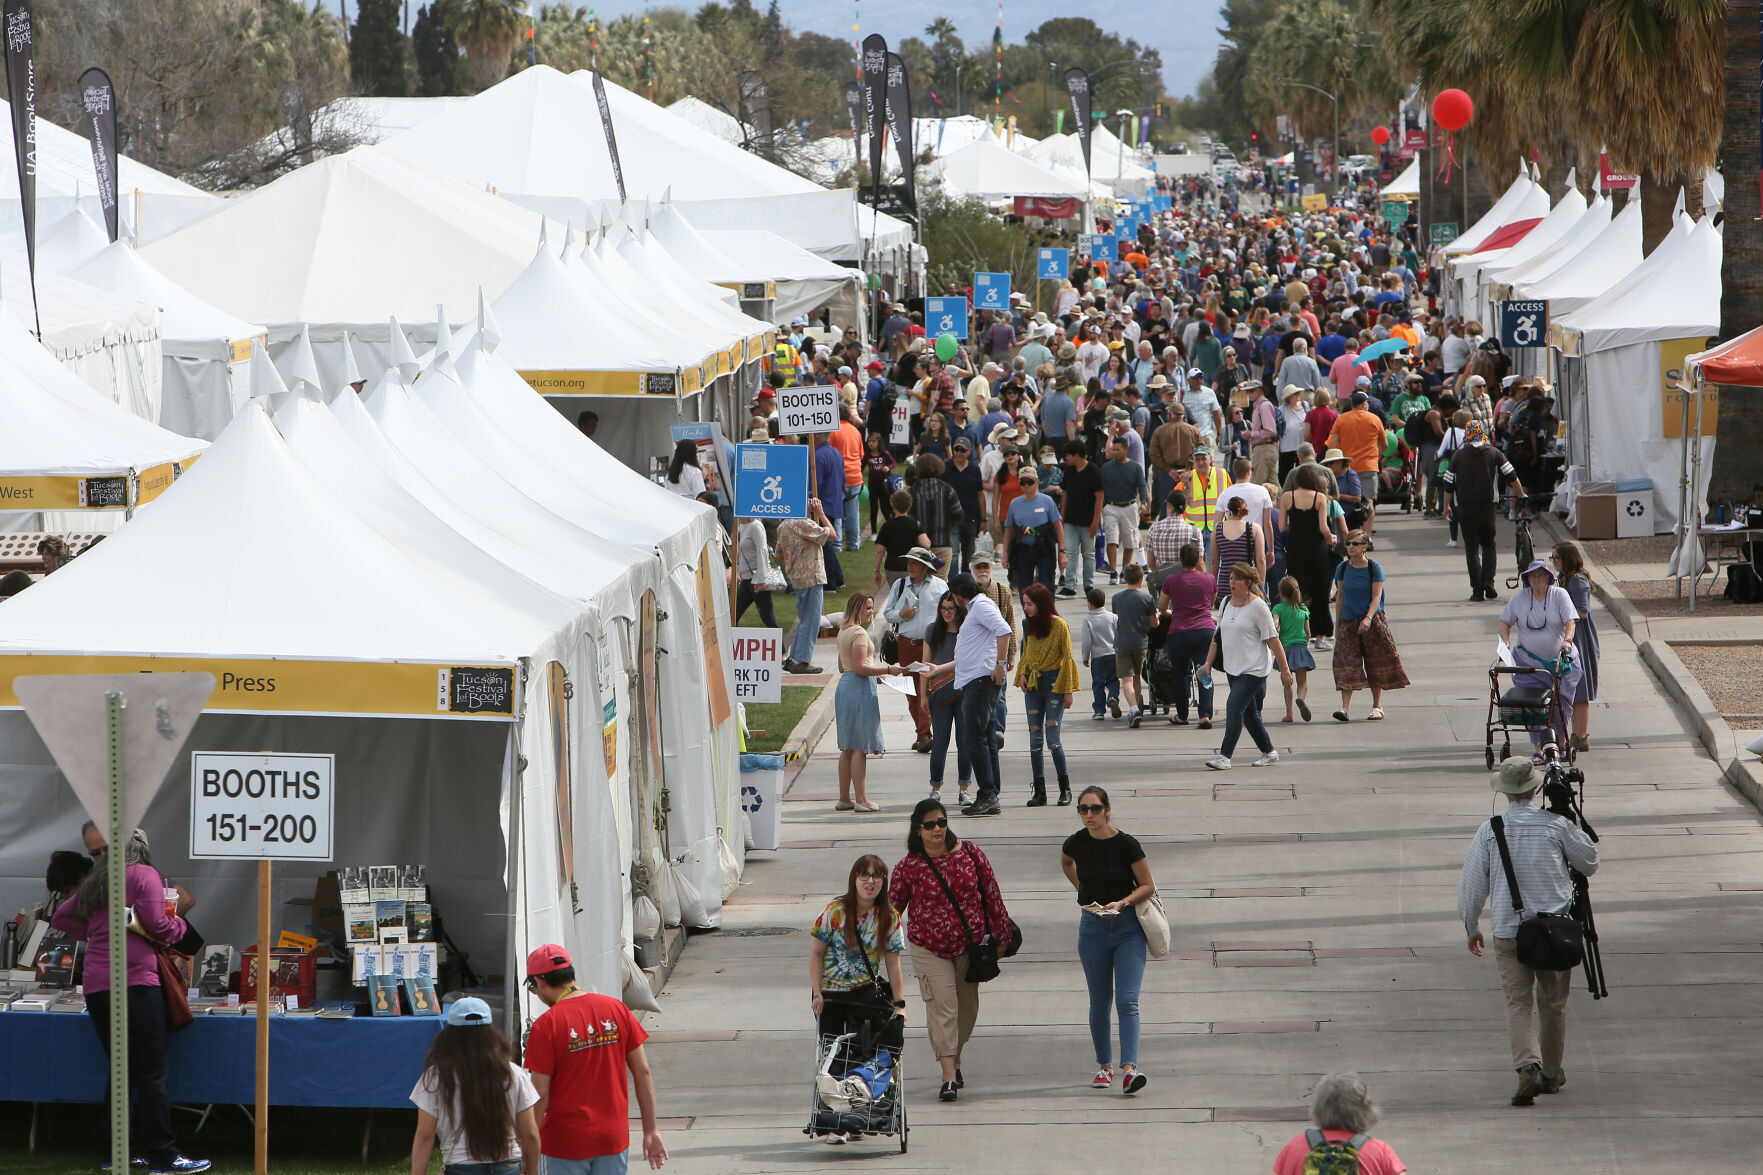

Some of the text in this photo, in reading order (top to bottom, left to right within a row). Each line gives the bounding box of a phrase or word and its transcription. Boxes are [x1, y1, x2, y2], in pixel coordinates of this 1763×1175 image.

[26, 151, 36, 175] UA
[1507, 302, 1544, 312] ACCESS
[782, 392, 833, 408] BOOTHS
[786, 411, 832, 427] 101-150
[0, 486, 34, 499] West
[90, 485, 124, 500] Festival
[91, 481, 121, 492] Tucson
[750, 504, 791, 514] ACCESS
[732, 638, 776, 661] MPH
[223, 672, 276, 692] Press
[458, 673, 503, 687] Tucson
[734, 668, 770, 682] RK TO
[457, 680, 507, 703] Festival
[736, 684, 758, 696] EFT
[469, 692, 504, 708] Books
[203, 768, 321, 800] BOOTHS
[206, 813, 317, 844] 151-200
